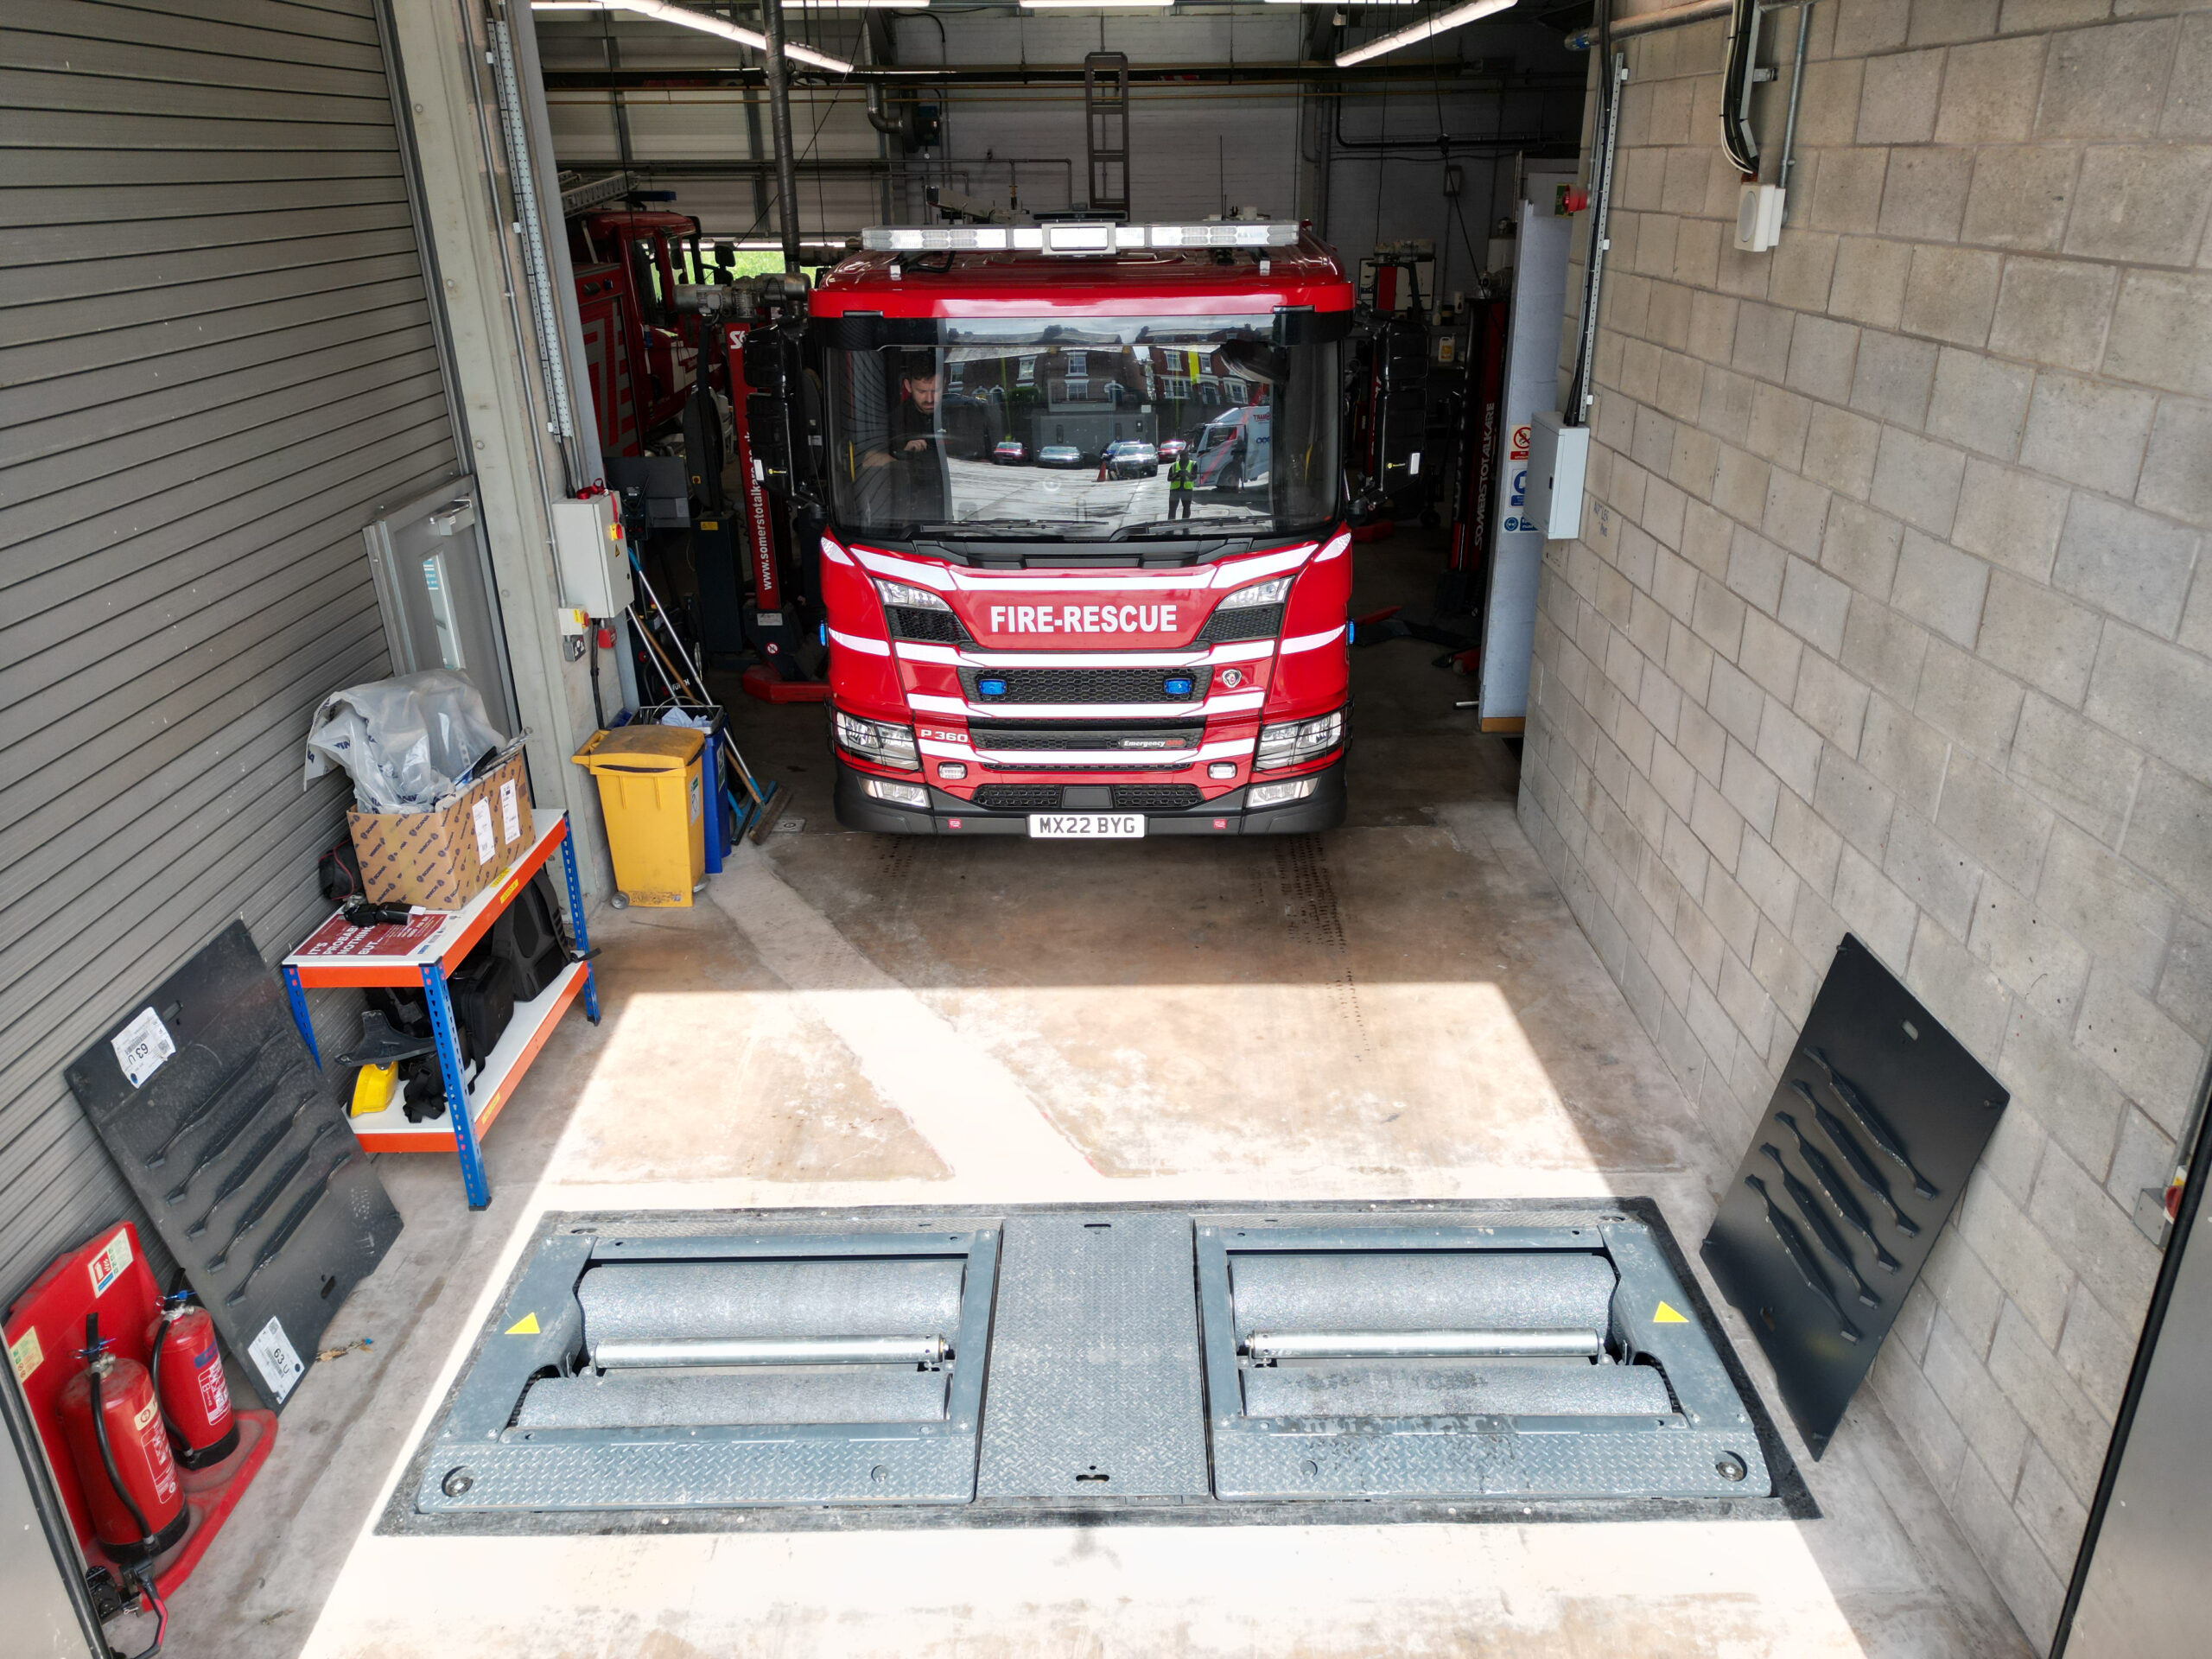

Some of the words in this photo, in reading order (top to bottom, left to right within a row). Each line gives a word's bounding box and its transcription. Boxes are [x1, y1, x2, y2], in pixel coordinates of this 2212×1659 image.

[990, 605, 1178, 632] FIRE-RESCUE
[934, 731, 969, 742] 360
[1039, 817, 1090, 834] MX22
[1097, 817, 1135, 834] BYG
[322, 925, 359, 955] PROBAB
[307, 942, 328, 955] IT'S
[135, 1043, 149, 1058] 63
[128, 1054, 137, 1065] U
[273, 1348, 285, 1364] 63
[283, 1364, 290, 1374] U
